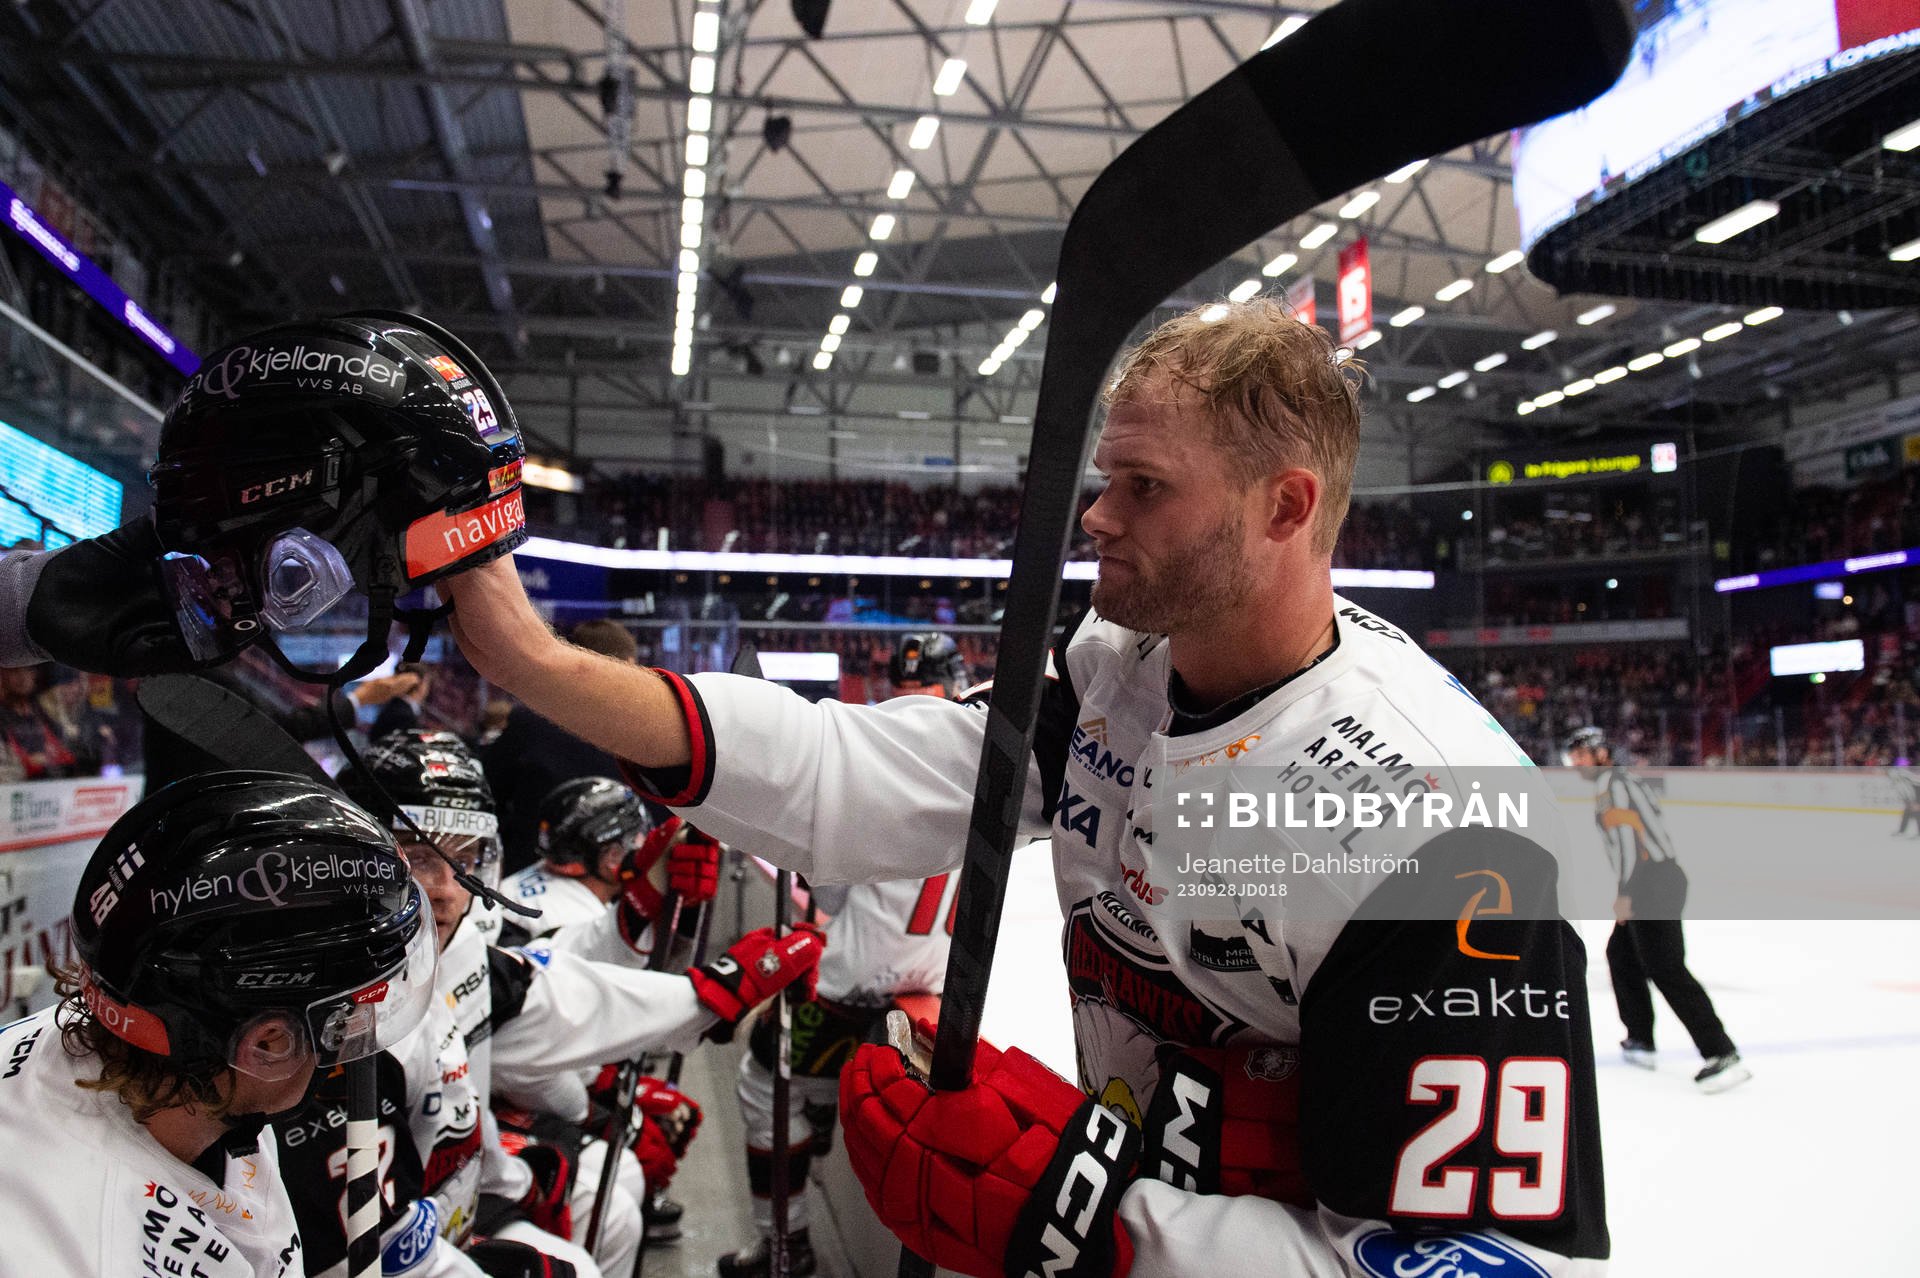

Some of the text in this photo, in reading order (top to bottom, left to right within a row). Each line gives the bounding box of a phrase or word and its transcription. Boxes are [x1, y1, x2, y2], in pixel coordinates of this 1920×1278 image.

[248, 346, 404, 388] kjellander
[297, 377, 364, 396] VVS AB
[240, 469, 314, 505] CCM
[150, 873, 233, 916] hylén
[290, 854, 397, 889] kjellander
[343, 884, 386, 896] VVS AB
[236, 972, 317, 987] CCM
[357, 985, 388, 1002] CCM
[1368, 977, 1571, 1025] exakta
[284, 1097, 398, 1148] exaa
[1386, 1054, 1572, 1222] 29
[142, 1185, 178, 1278] ALMO
